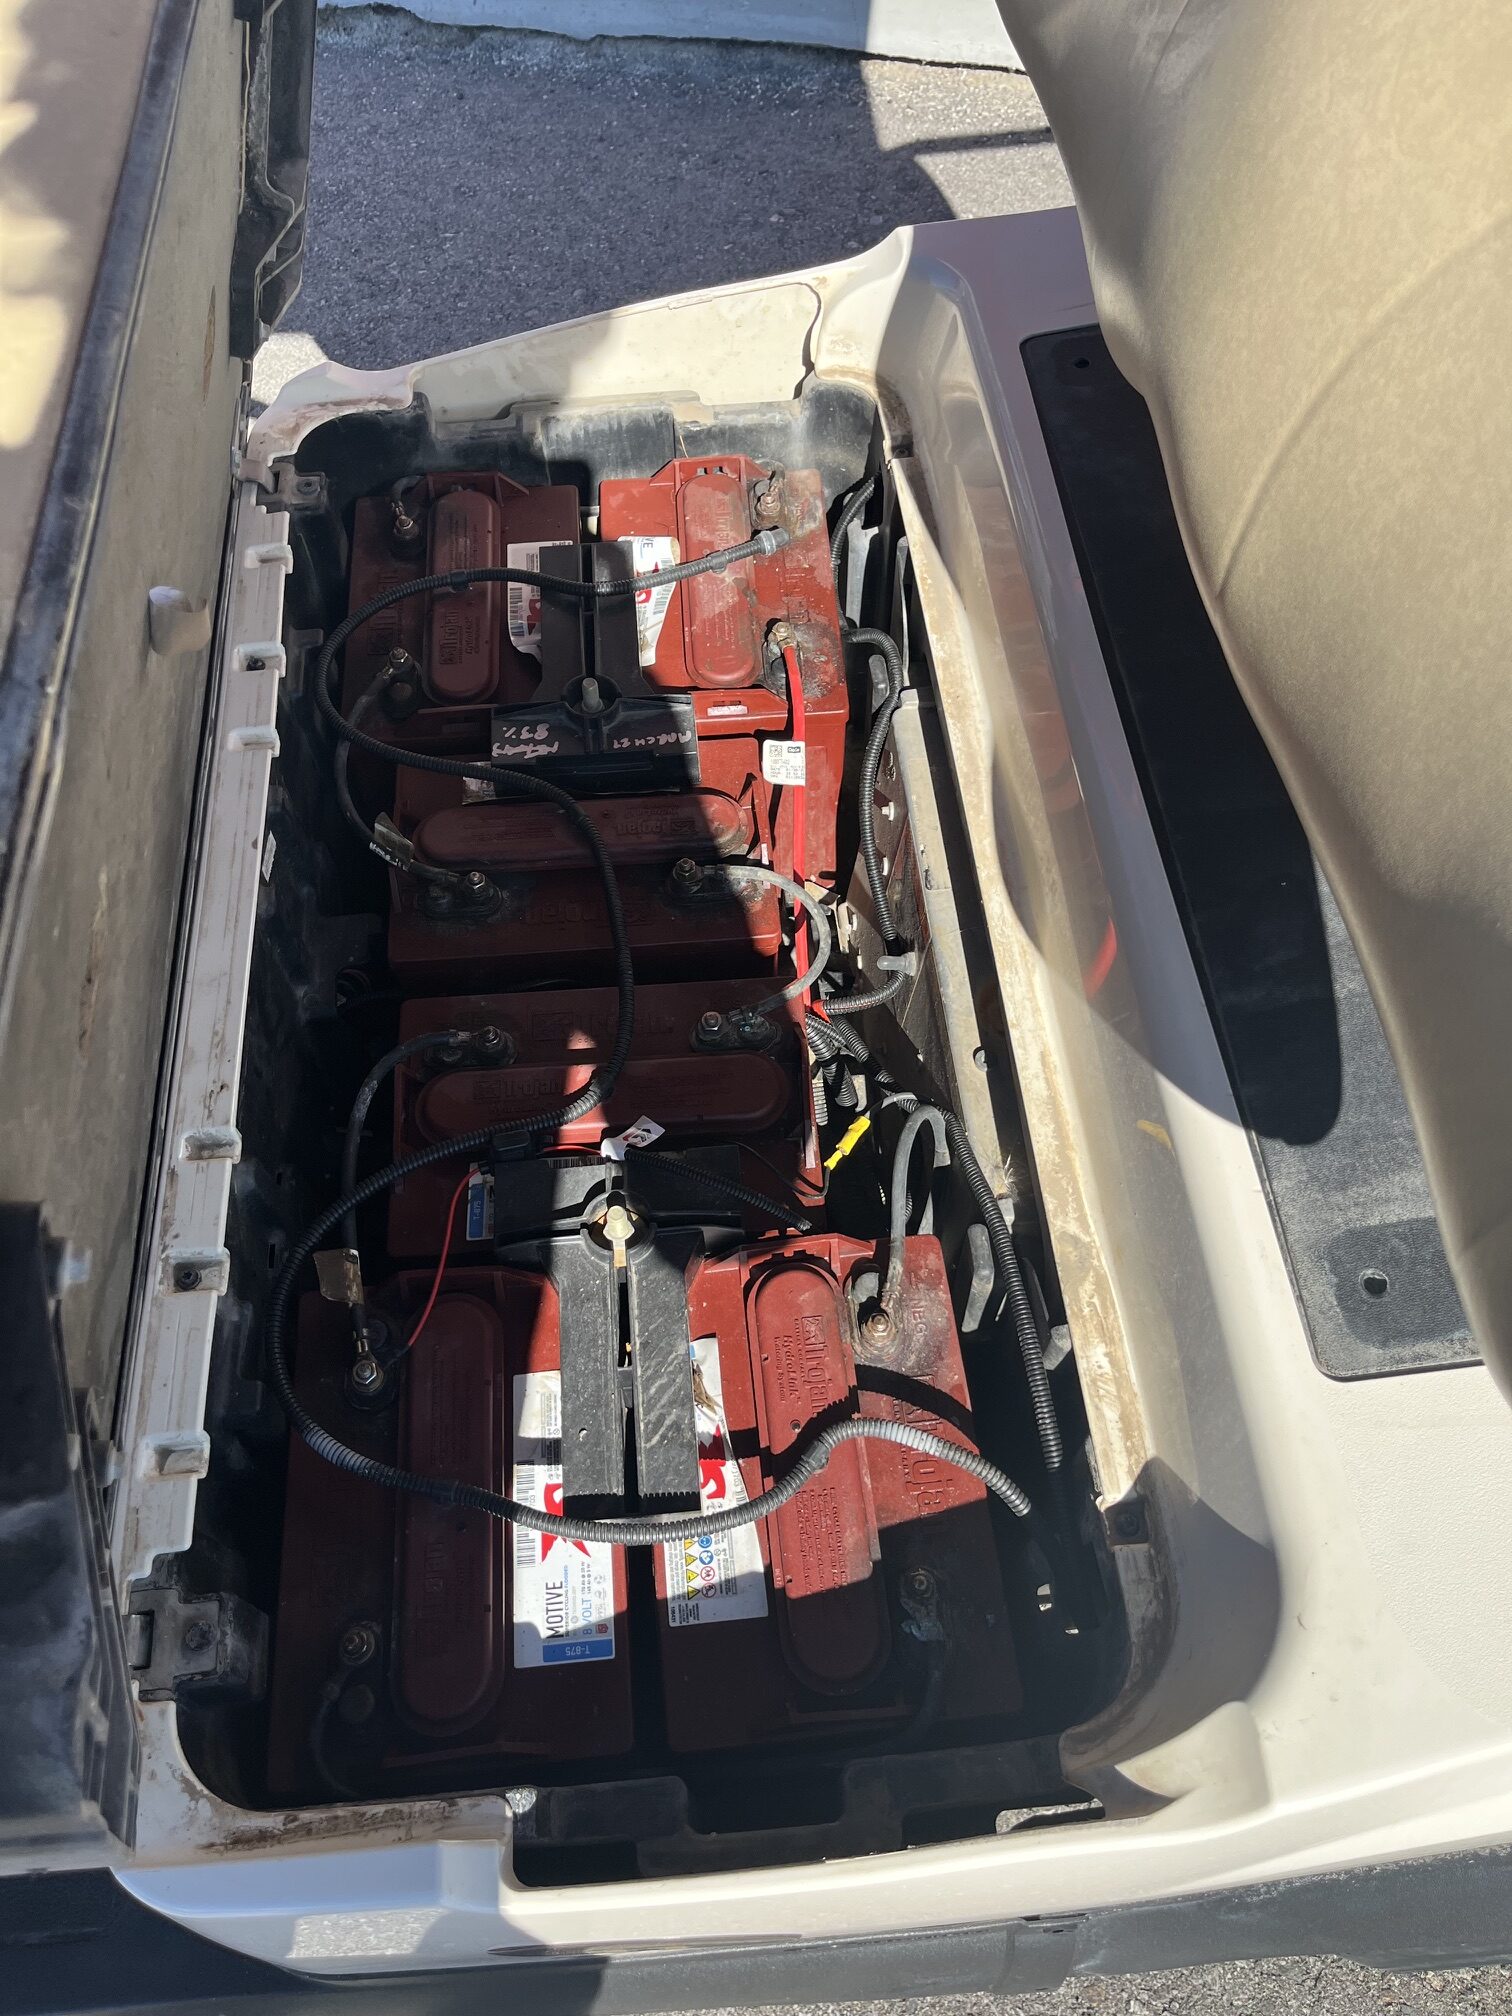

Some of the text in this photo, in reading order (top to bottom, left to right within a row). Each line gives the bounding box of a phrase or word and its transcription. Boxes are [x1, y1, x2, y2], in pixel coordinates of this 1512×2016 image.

[545, 1581, 564, 1639] MOTIVE
[582, 1598, 593, 1624] VOLT
[565, 1645, 591, 1656] T-875
